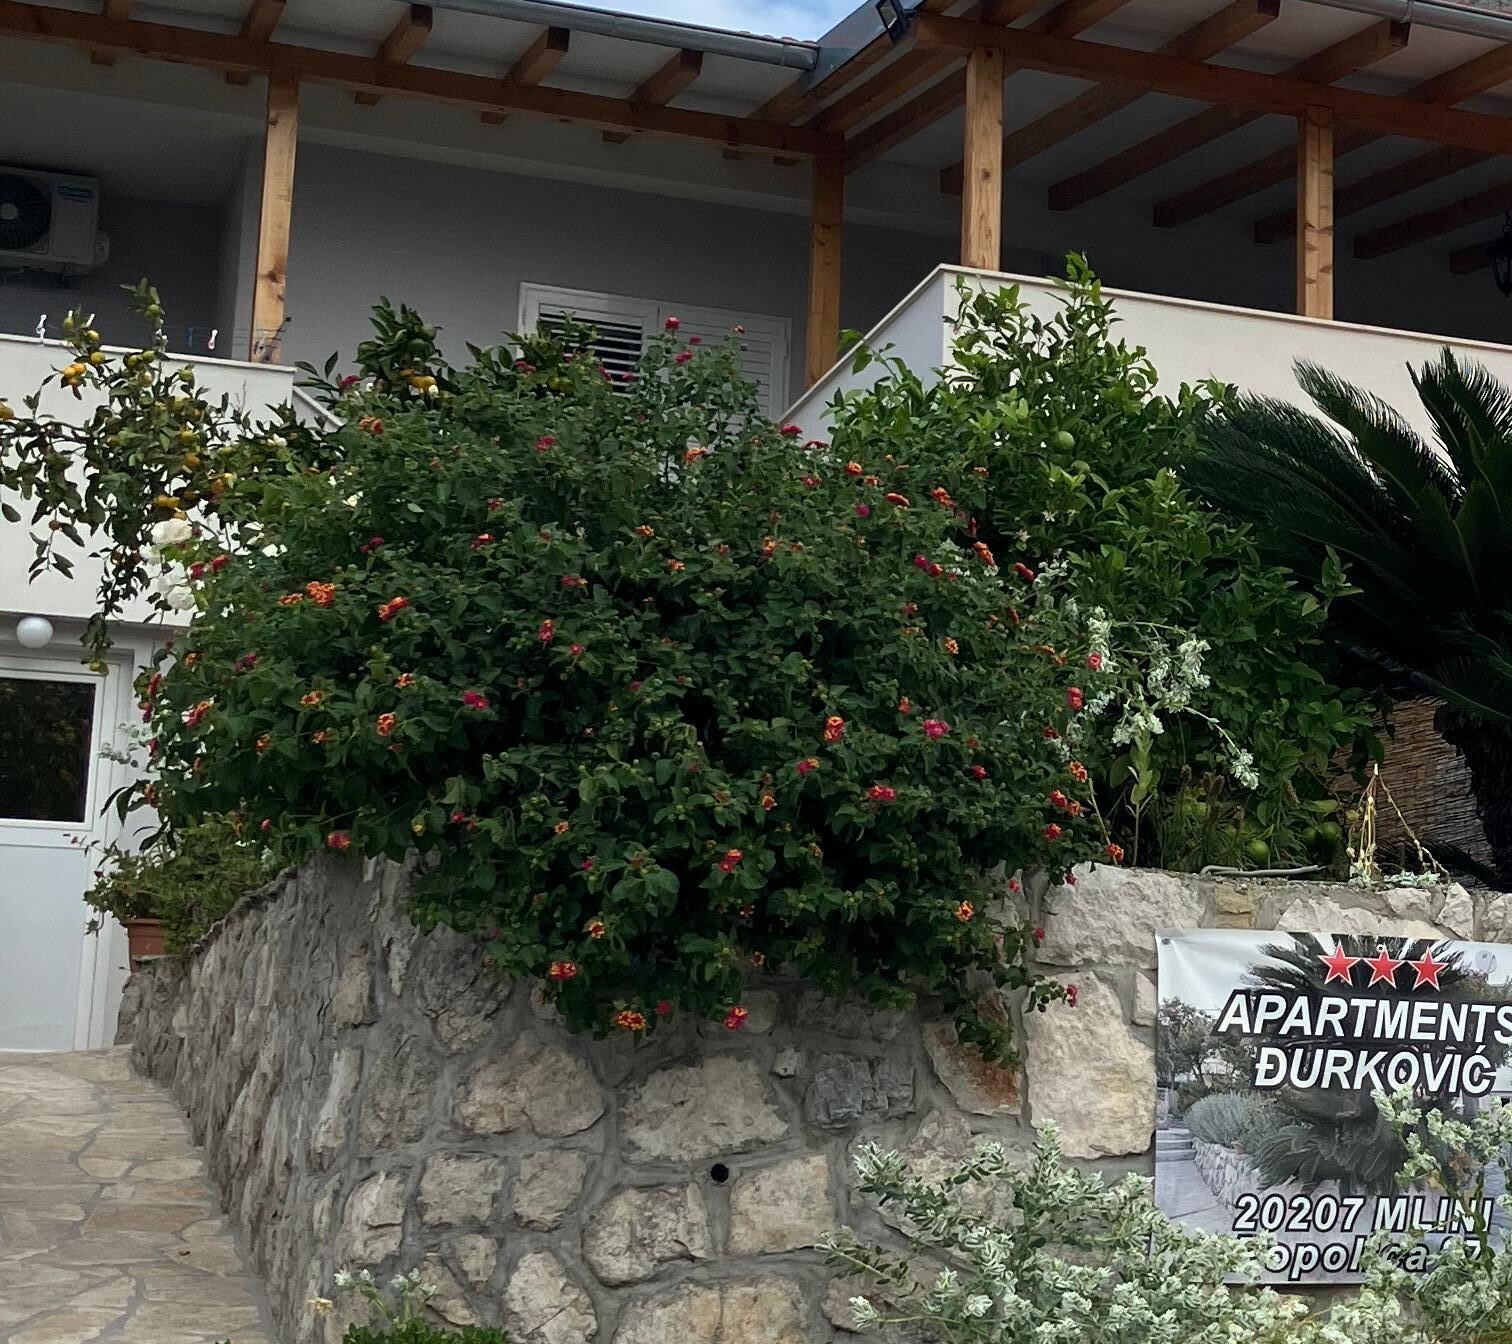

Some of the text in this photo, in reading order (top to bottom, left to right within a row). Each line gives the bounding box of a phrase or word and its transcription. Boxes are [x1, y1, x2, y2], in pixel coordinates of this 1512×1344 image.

[1253, 1042, 1498, 1095] ĐURKOVIĆ
[1233, 1193, 1493, 1233] 20207 MLINI
